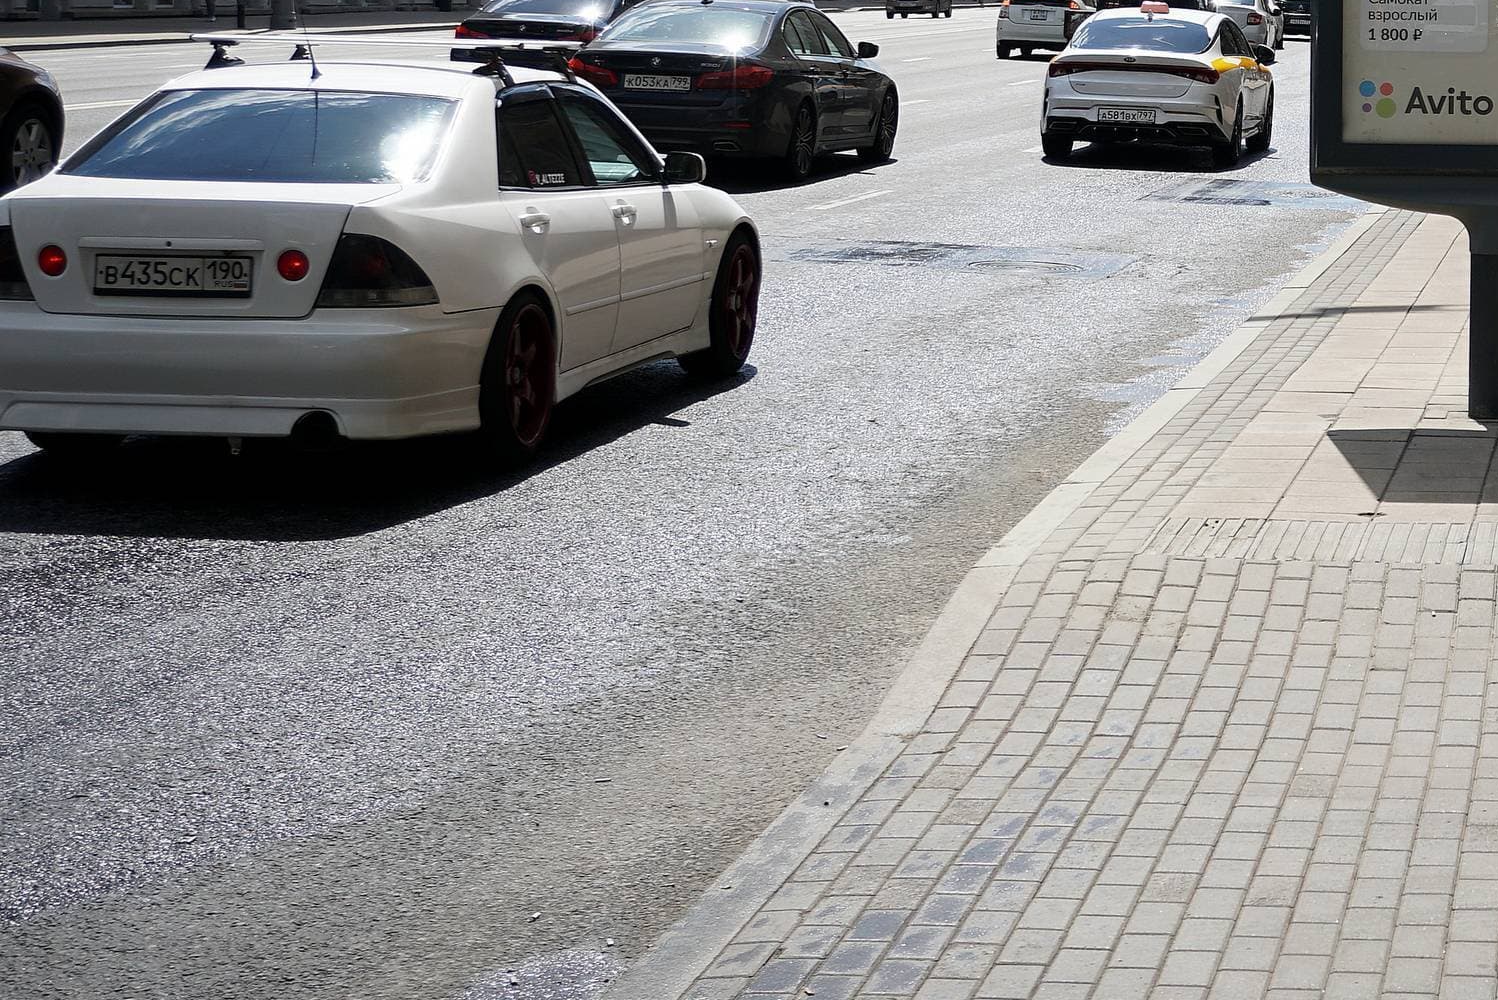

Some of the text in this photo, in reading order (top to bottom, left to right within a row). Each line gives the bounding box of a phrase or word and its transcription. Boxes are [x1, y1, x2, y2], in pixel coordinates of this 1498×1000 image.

[1368, 8, 1438, 22] взрослый
[627, 75, 689, 88] К053КА 799
[1404, 86, 1494, 116] Avito
[1101, 110, 1153, 121] А581ВХ 797
[104, 260, 244, 287] В435СК 190
[214, 280, 233, 288] RUS
